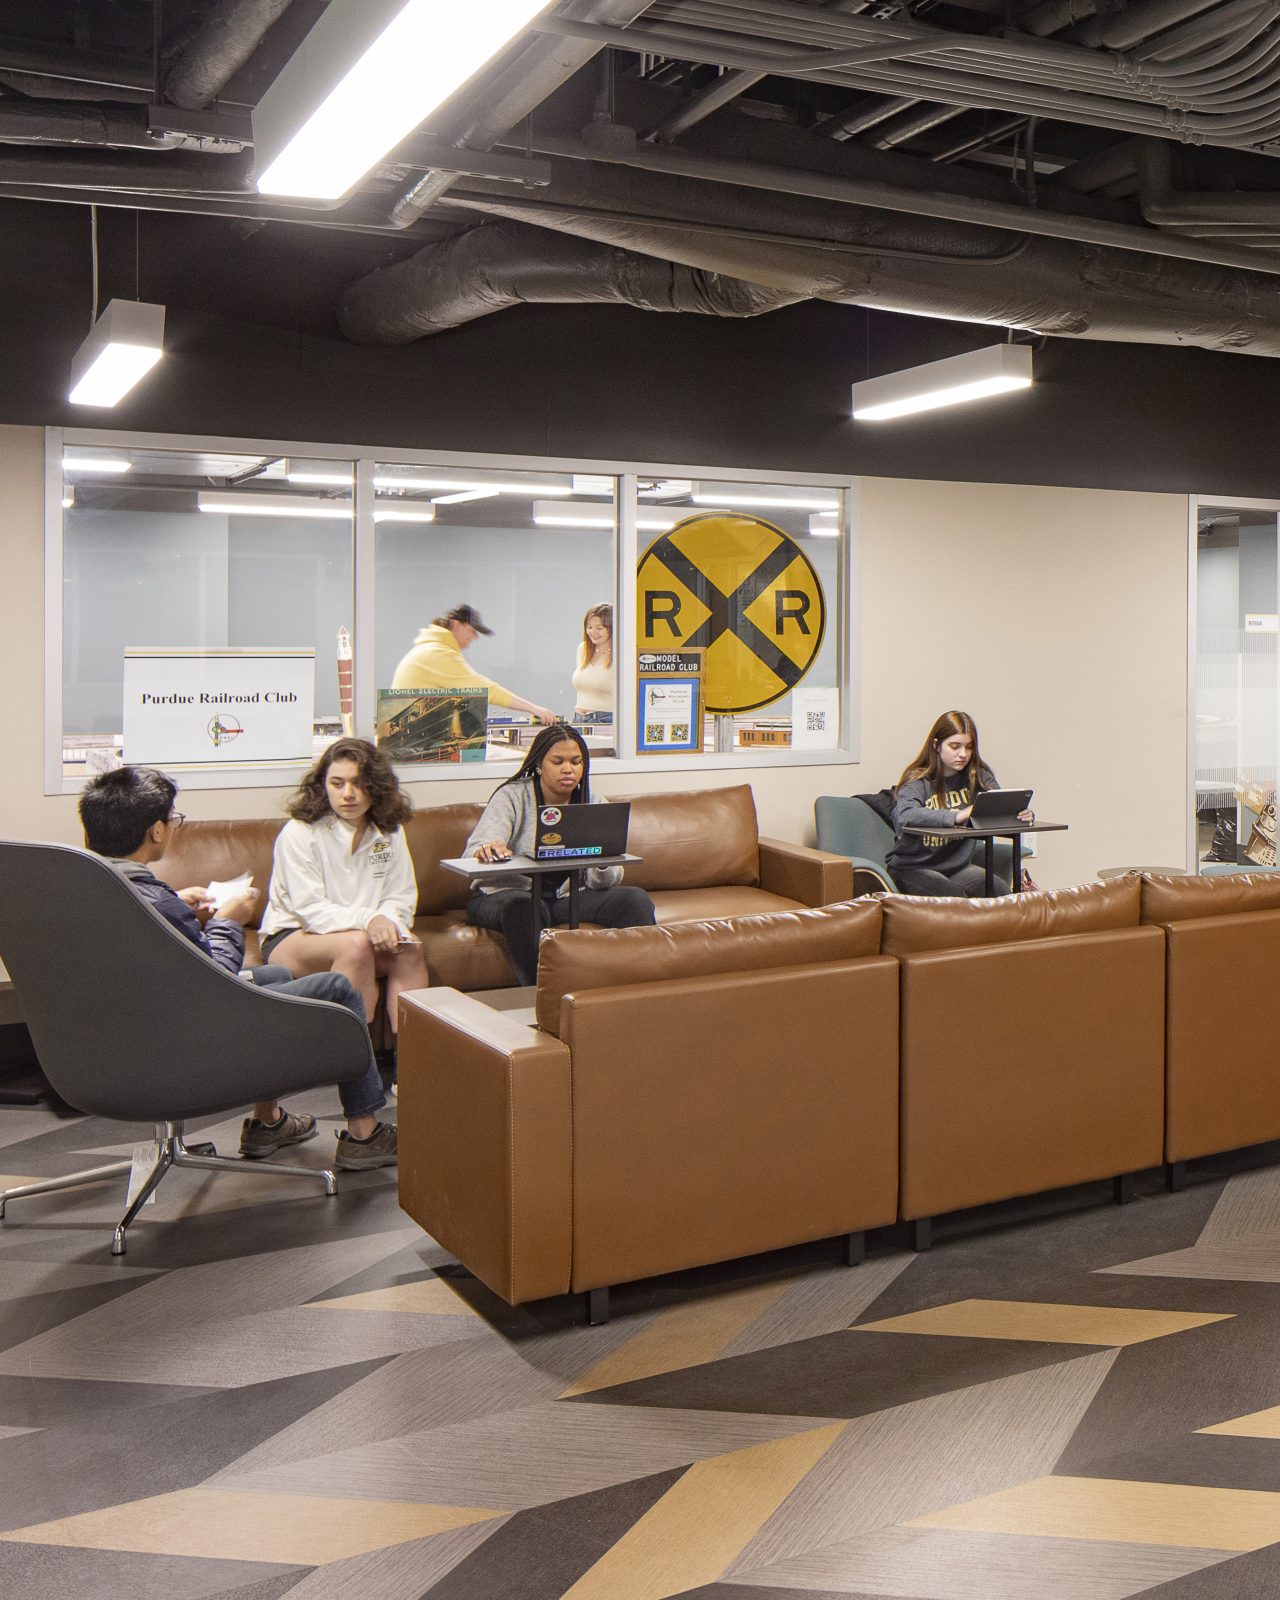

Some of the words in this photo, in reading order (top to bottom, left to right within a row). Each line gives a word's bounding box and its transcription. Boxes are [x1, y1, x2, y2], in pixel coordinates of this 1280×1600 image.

[645, 590, 682, 637] R
[775, 590, 810, 635] R
[639, 663, 675, 671] RAILROAD
[679, 663, 698, 671] CLUB
[142, 693, 194, 704] Purdue
[200, 692, 259, 704] Railroad
[264, 692, 297, 703] Club
[368, 852, 393, 861] PURDU
